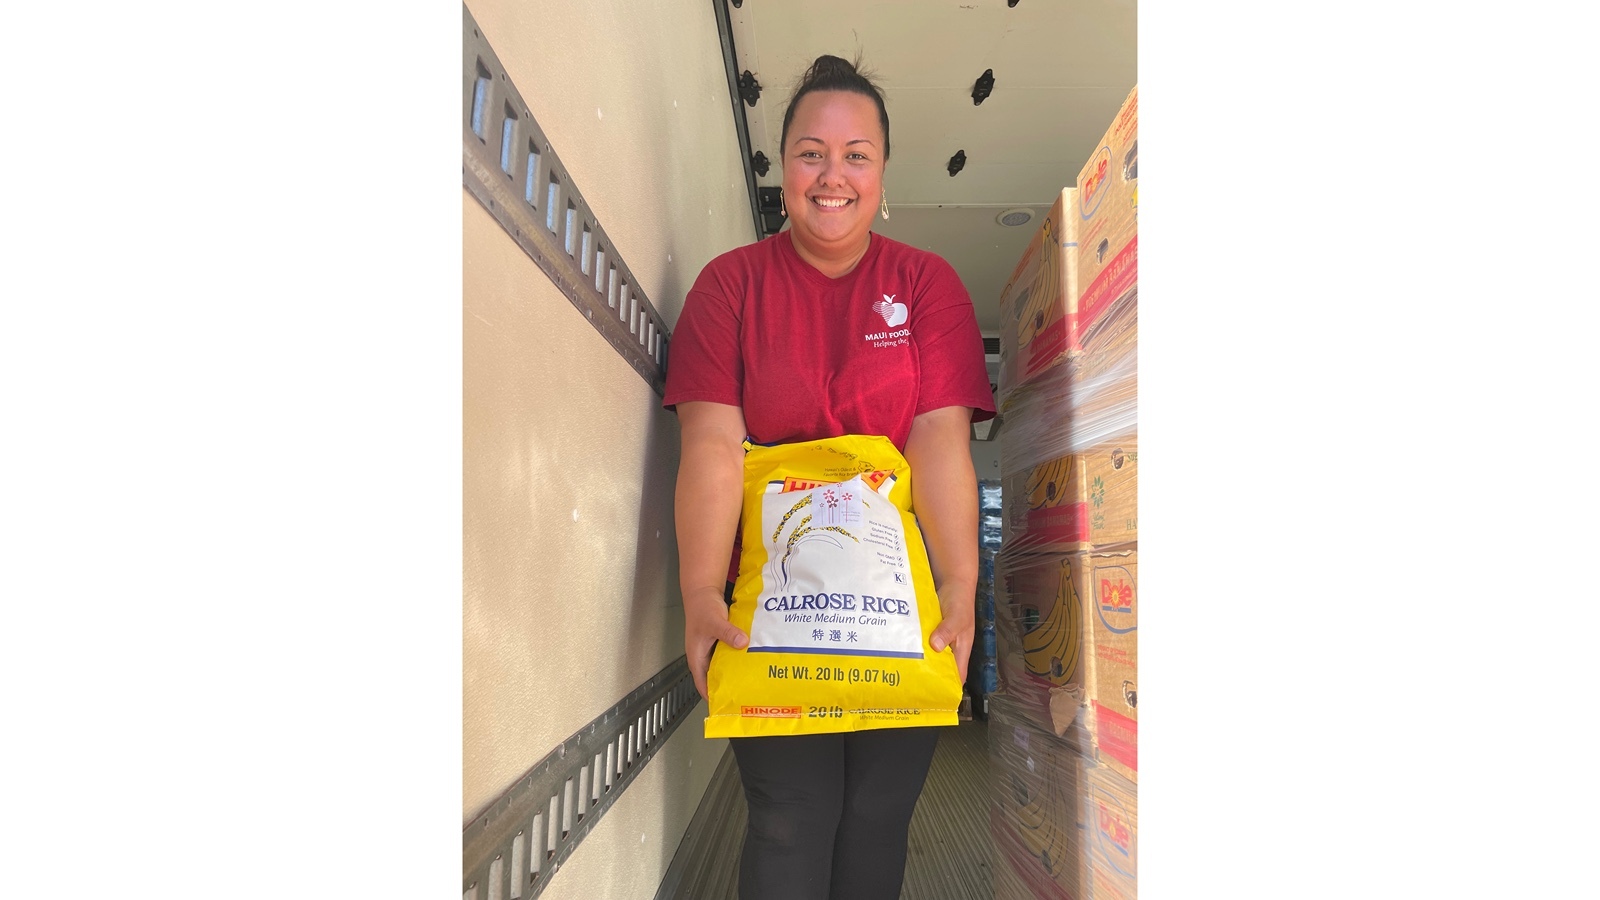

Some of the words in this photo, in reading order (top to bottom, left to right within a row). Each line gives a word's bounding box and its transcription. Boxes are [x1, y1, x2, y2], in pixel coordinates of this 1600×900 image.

[1084, 159, 1107, 204] Dole
[865, 332, 887, 341] MAUI
[873, 340, 898, 348] Helping
[1101, 578, 1132, 607] Dole
[764, 593, 856, 612] CALROSE
[861, 595, 910, 616] RICE
[784, 613, 812, 623] White
[814, 613, 856, 624] Medium
[858, 615, 887, 626] Grain
[812, 628, 858, 643] 特選米
[768, 665, 788, 679] Net
[792, 665, 813, 680] Wt.
[815, 667, 831, 681] 20
[833, 667, 845, 682] lb
[848, 668, 879, 685] (9.07
[882, 669, 900, 687] kg)
[744, 707, 798, 715] HINODE
